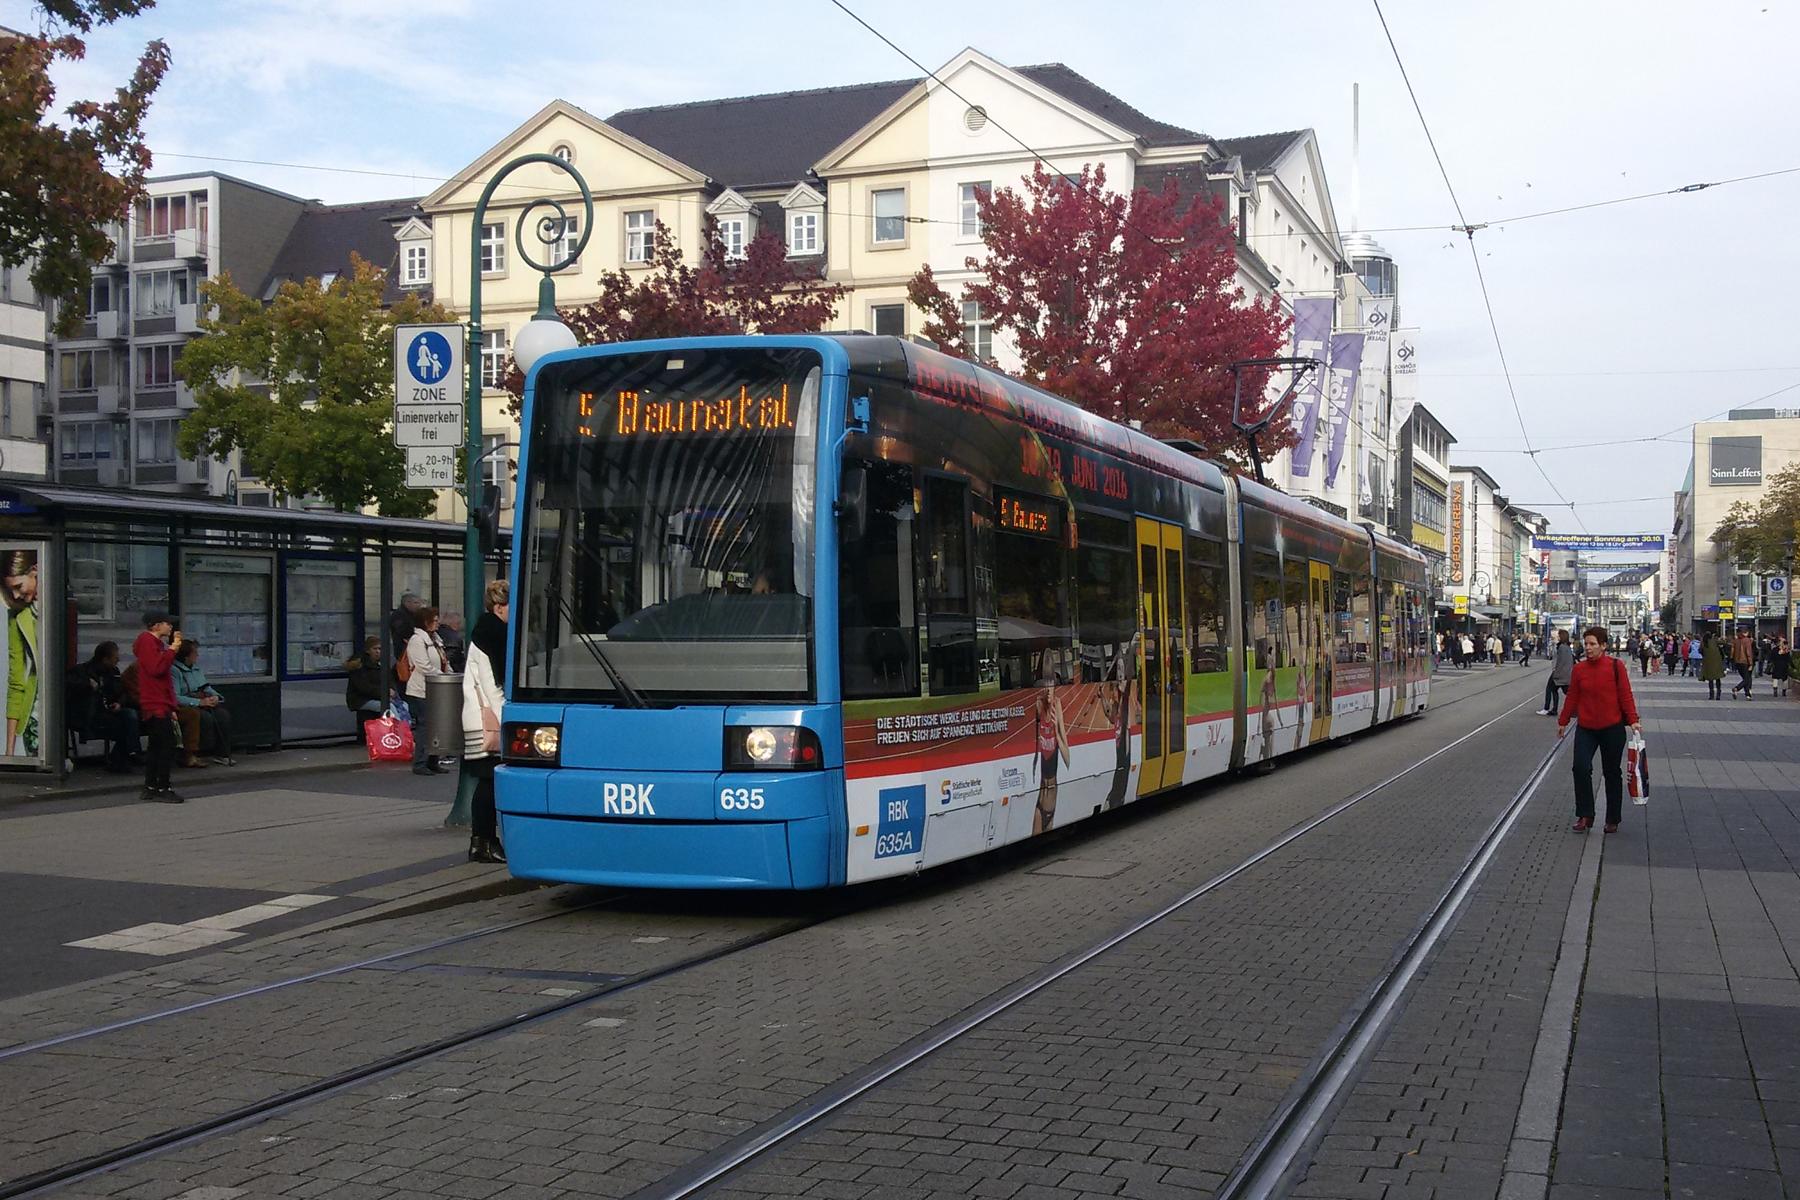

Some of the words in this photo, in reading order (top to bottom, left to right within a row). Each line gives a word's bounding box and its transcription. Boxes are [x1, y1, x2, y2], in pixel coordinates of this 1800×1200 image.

[412, 388, 446, 401] ZONE
[397, 411, 459, 424] Linienverkehr
[580, 393, 592, 435] 5
[421, 427, 438, 439] frei
[426, 455, 453, 465] 20-9h
[431, 468, 448, 479] frei
[1072, 454, 1099, 491] JUNI
[1103, 466, 1129, 500] 2016
[1712, 467, 1761, 478] SinnLeffers
[1452, 485, 1462, 569] SPORTARENA
[877, 717, 893, 729] DIE
[895, 713, 939, 729] STÄDTISCHE
[940, 711, 960, 724] WERKE
[961, 710, 969, 722] AG
[970, 708, 980, 721] UND
[877, 730, 909, 745] FREUEN
[912, 728, 928, 742] SICH
[930, 727, 942, 740] AUF
[943, 723, 975, 738] SPANNENDE
[603, 783, 656, 815] RBK
[720, 788, 765, 810] 635
[888, 799, 909, 822] RBK
[877, 830, 913, 855] 635A
